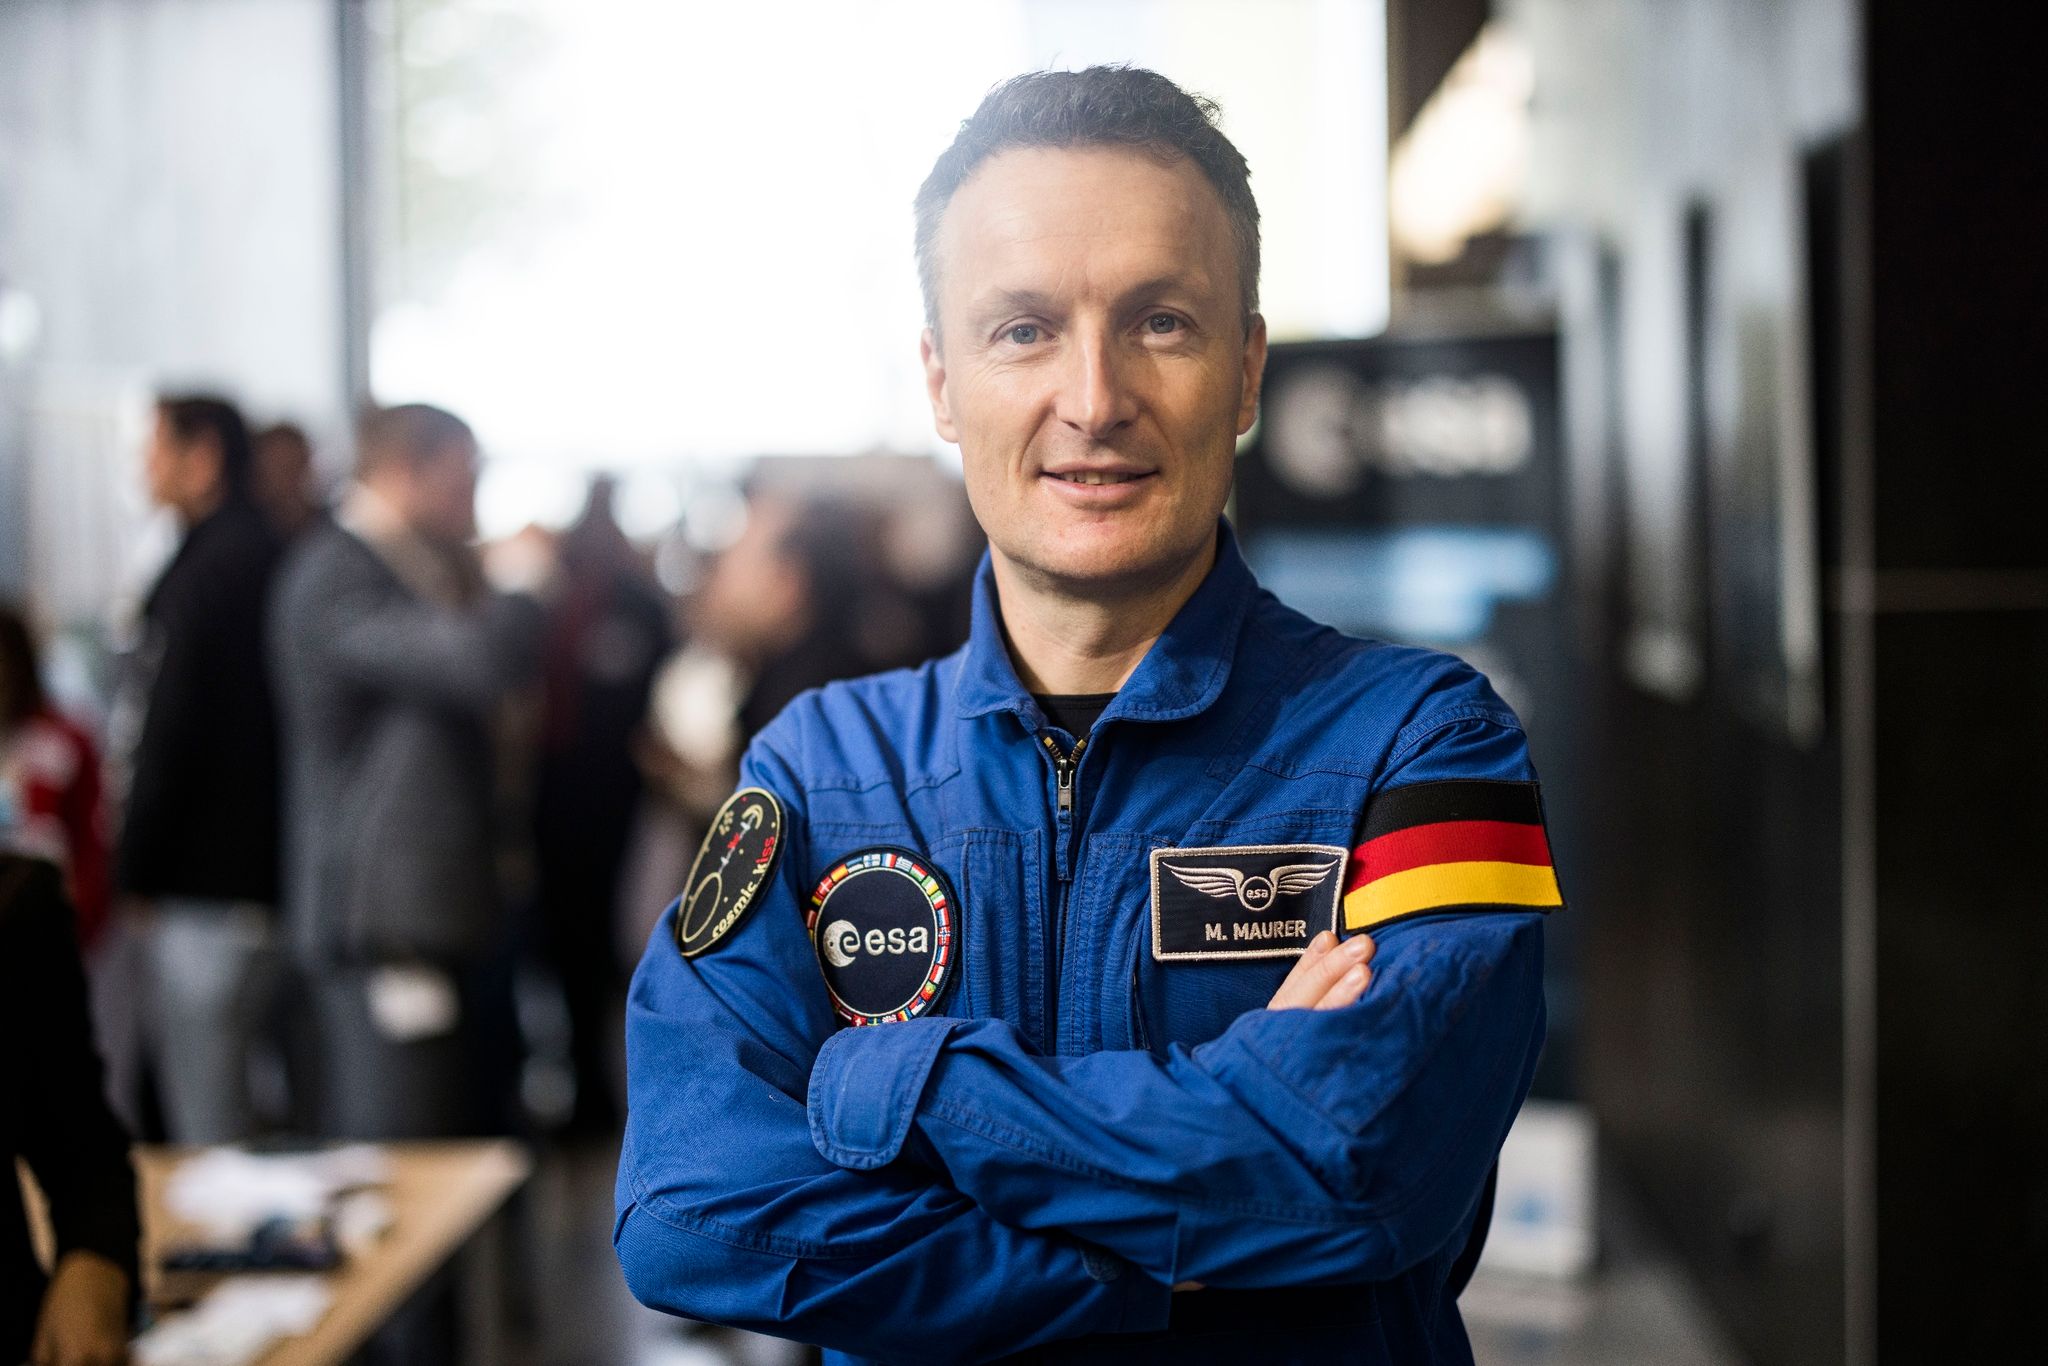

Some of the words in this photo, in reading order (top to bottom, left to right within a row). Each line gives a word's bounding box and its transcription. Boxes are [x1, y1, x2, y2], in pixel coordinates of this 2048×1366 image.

[712, 881, 757, 938] cosmic
[753, 836, 775, 875] kiss
[1246, 888, 1269, 900] esa
[865, 926, 928, 956] esa
[1205, 923, 1228, 941] M.
[1233, 920, 1307, 941] MAURER
